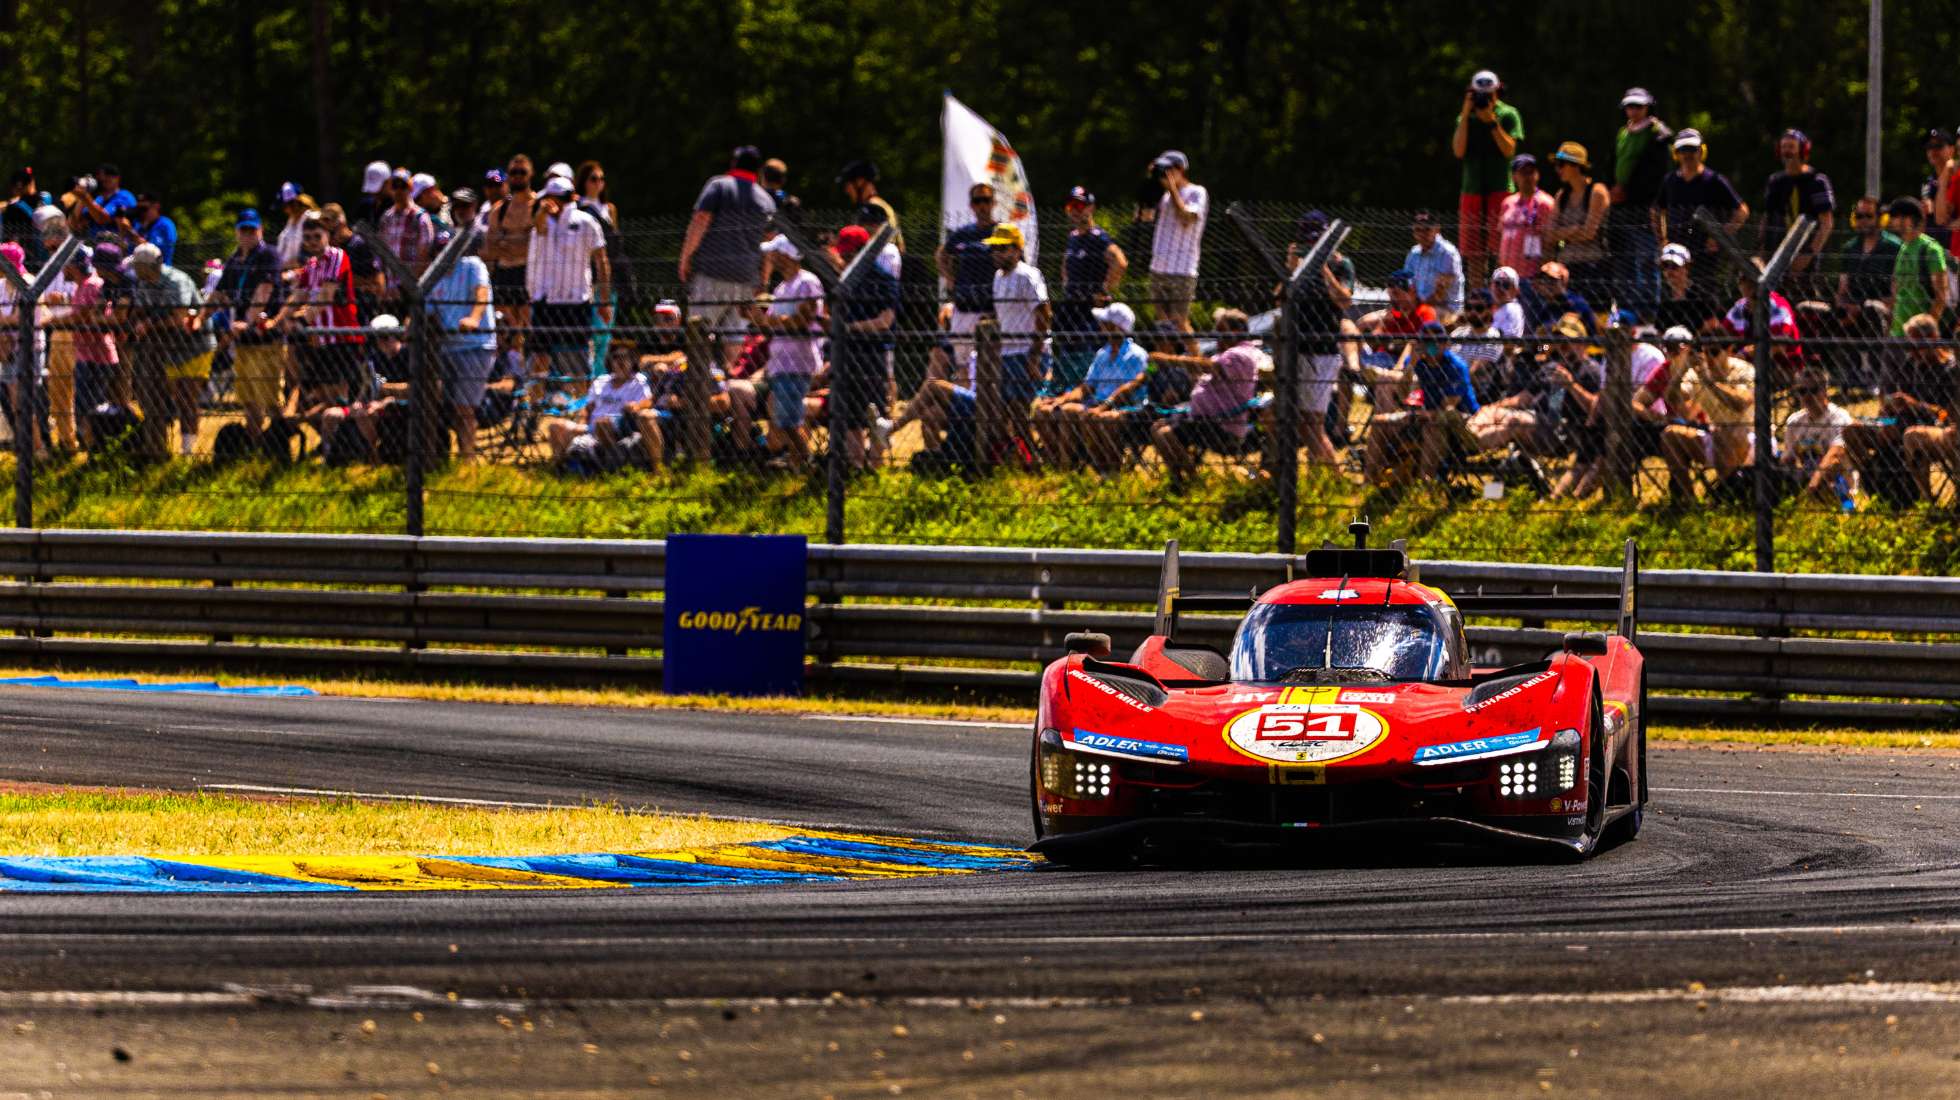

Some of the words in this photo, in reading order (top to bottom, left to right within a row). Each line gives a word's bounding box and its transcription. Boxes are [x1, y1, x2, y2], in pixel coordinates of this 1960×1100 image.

[678, 607, 802, 634] GOODYEAR
[1523, 670, 1559, 689] MILLE
[1069, 669, 1117, 695] RICHARD
[1116, 693, 1154, 713] MILLE
[1232, 692, 1275, 704] HY
[1261, 715, 1350, 737] 51
[1077, 735, 1142, 751] ADLER
[1423, 740, 1489, 758] ADLER
